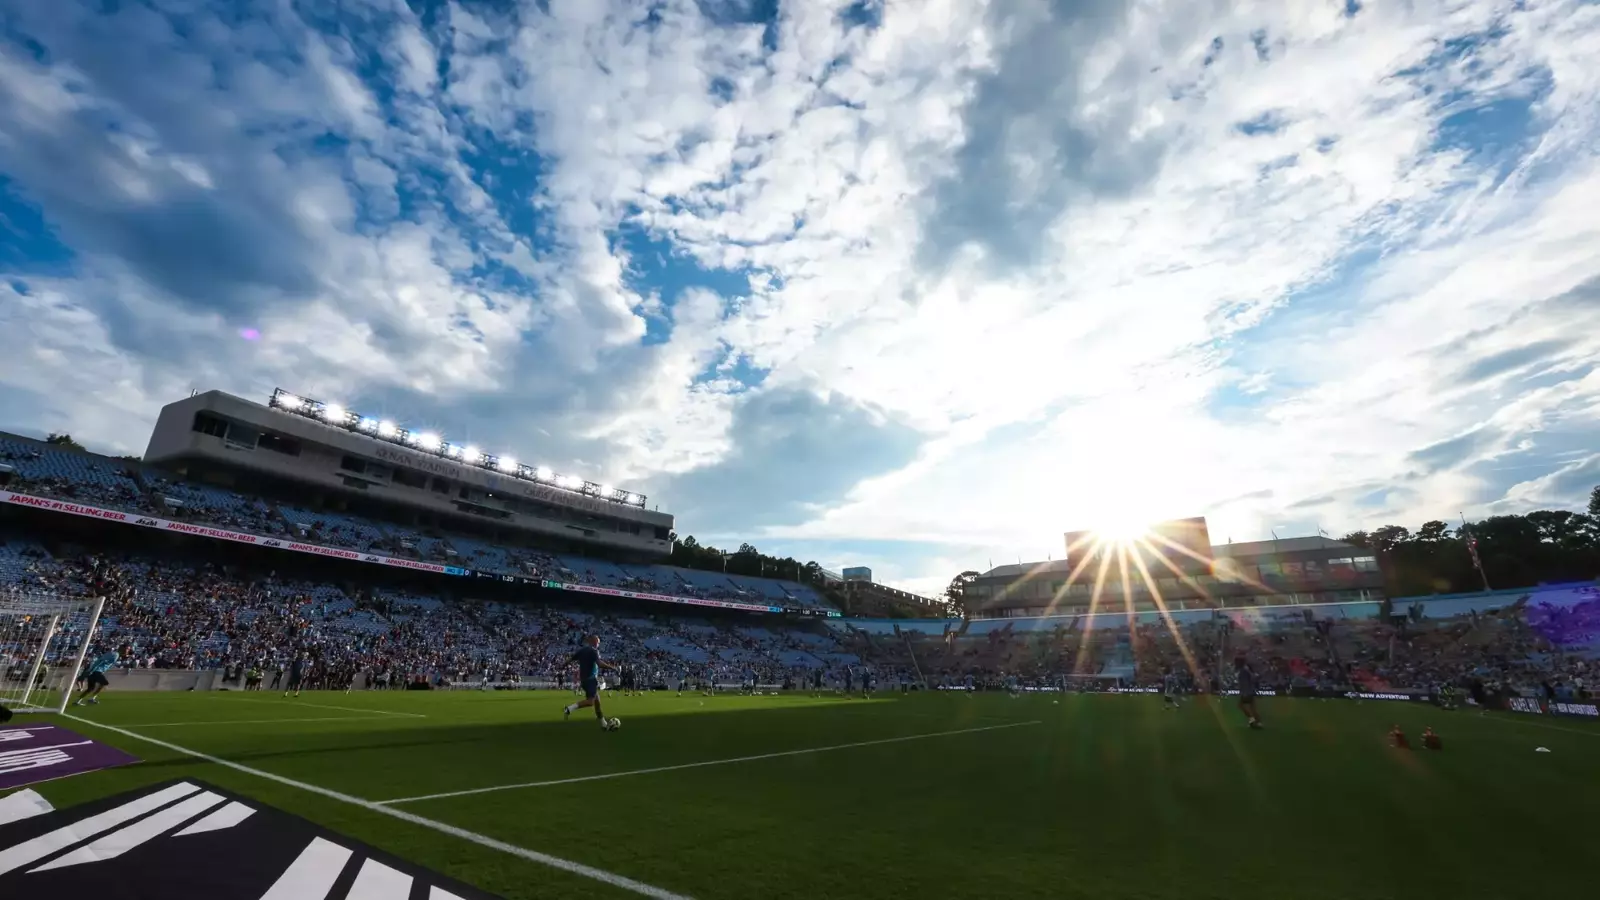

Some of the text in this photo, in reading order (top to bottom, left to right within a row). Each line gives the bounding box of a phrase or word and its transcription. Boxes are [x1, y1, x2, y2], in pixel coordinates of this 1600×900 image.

[376, 448, 412, 465] KENAN
[8, 494, 126, 521] JAPAN'S #1 SELLING BEER
[135, 518, 158, 527] Asahi
[167, 522, 198, 533] JAPAN'S
[208, 529, 238, 540] SELLING
[238, 534, 256, 543] BEER
[288, 542, 313, 552] JAPAN'S
[321, 548, 344, 557] SELLING
[412, 562, 432, 571] SELLING
[1509, 697, 1530, 712] CHAPEL
[1567, 703, 1599, 717] ADVENTURES
